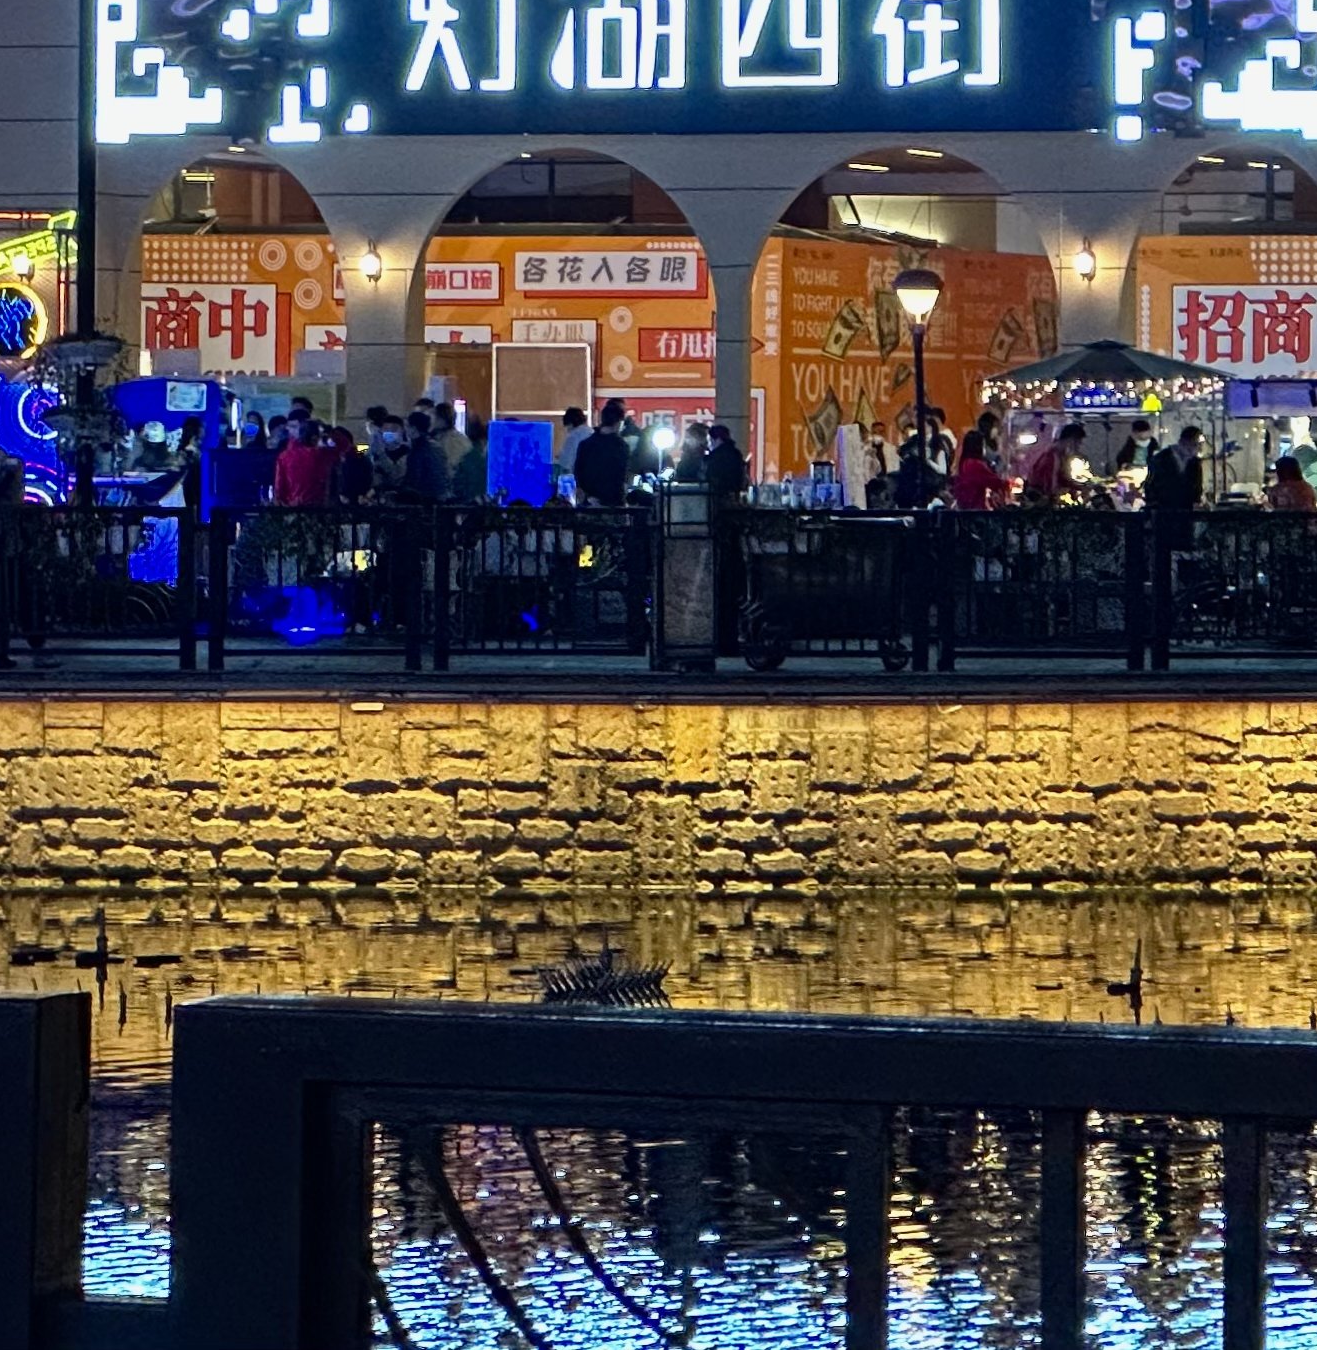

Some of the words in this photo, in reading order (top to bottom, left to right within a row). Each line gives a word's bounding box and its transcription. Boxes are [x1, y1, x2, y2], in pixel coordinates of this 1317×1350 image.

[522, 255, 688, 284] 各花入各眼
[839, 364, 891, 403] HAVE
